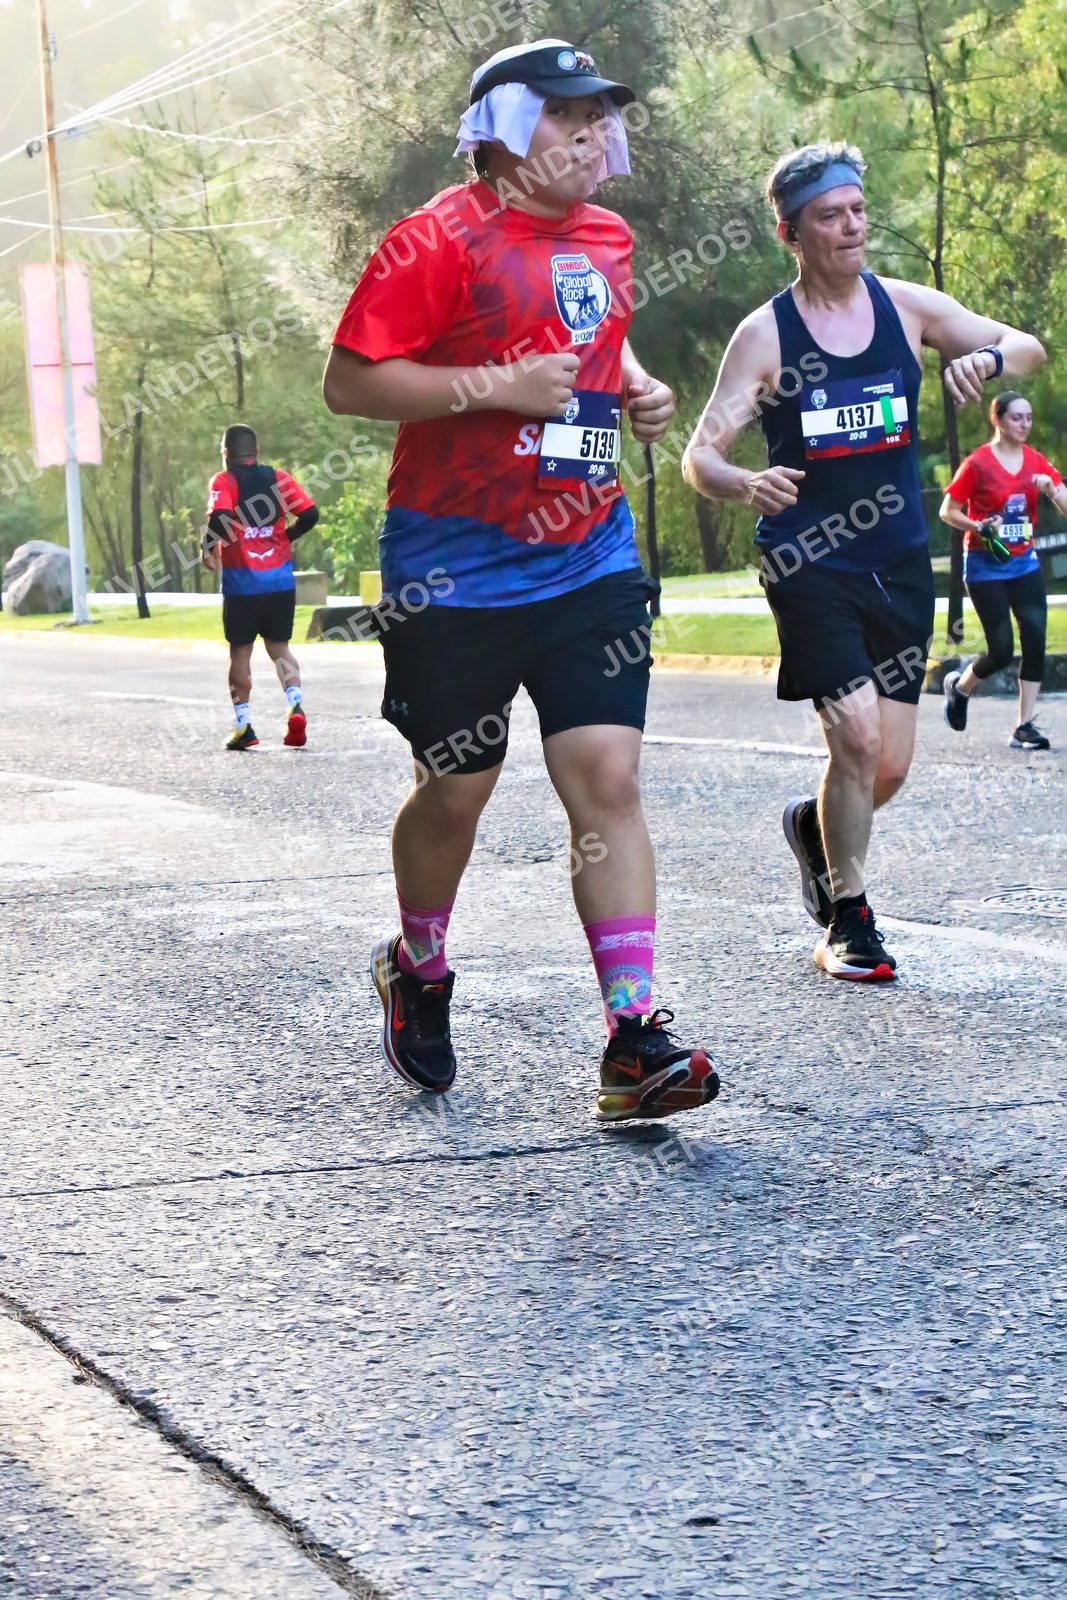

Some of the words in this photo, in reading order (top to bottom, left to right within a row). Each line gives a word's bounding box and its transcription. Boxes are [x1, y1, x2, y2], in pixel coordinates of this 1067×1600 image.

[557, 262, 587, 271] BIMBO
[563, 274, 592, 289] Global
[562, 287, 584, 301] Race
[836, 404, 874, 430] 4137
[580, 429, 615, 460] 5139
[885, 435, 900, 444] 10K
